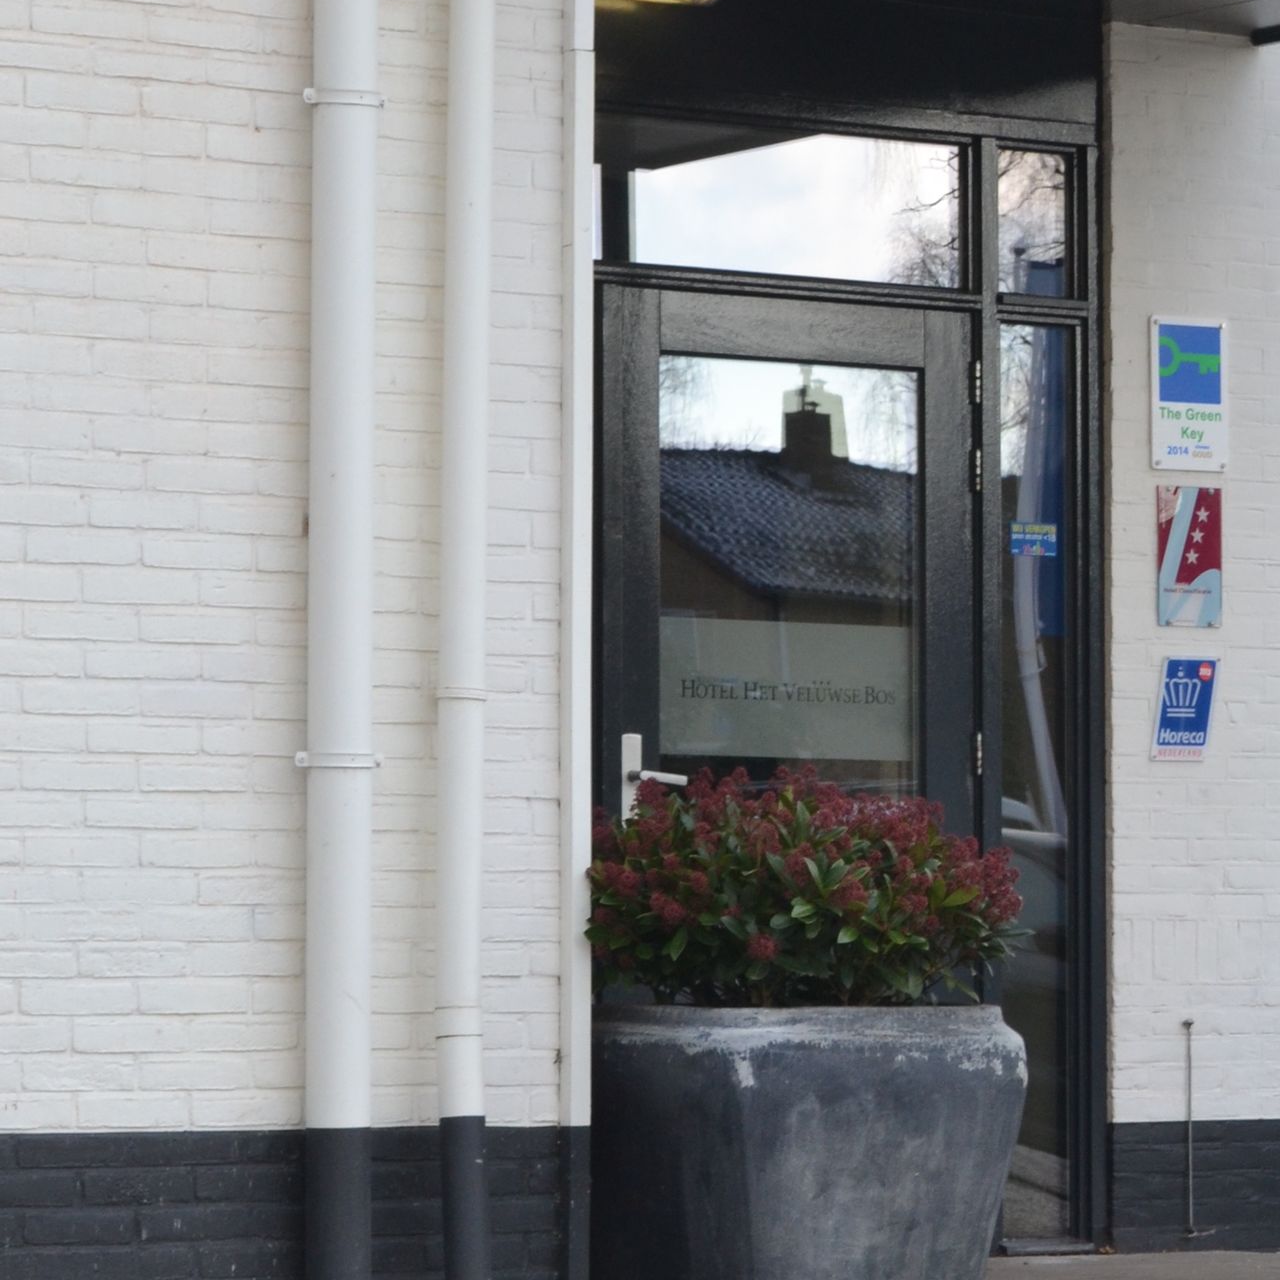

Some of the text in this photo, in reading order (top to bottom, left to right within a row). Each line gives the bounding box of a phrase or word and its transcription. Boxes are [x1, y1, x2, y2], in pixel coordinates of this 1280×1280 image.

[1159, 407, 1222, 422] The Green
[1181, 426, 1204, 442] Key
[1167, 445, 1189, 455] 2014
[680, 679, 738, 700] HOTEL
[744, 681, 778, 701] HET
[865, 686, 896, 705] BOS
[1159, 727, 1205, 744] Horeca
